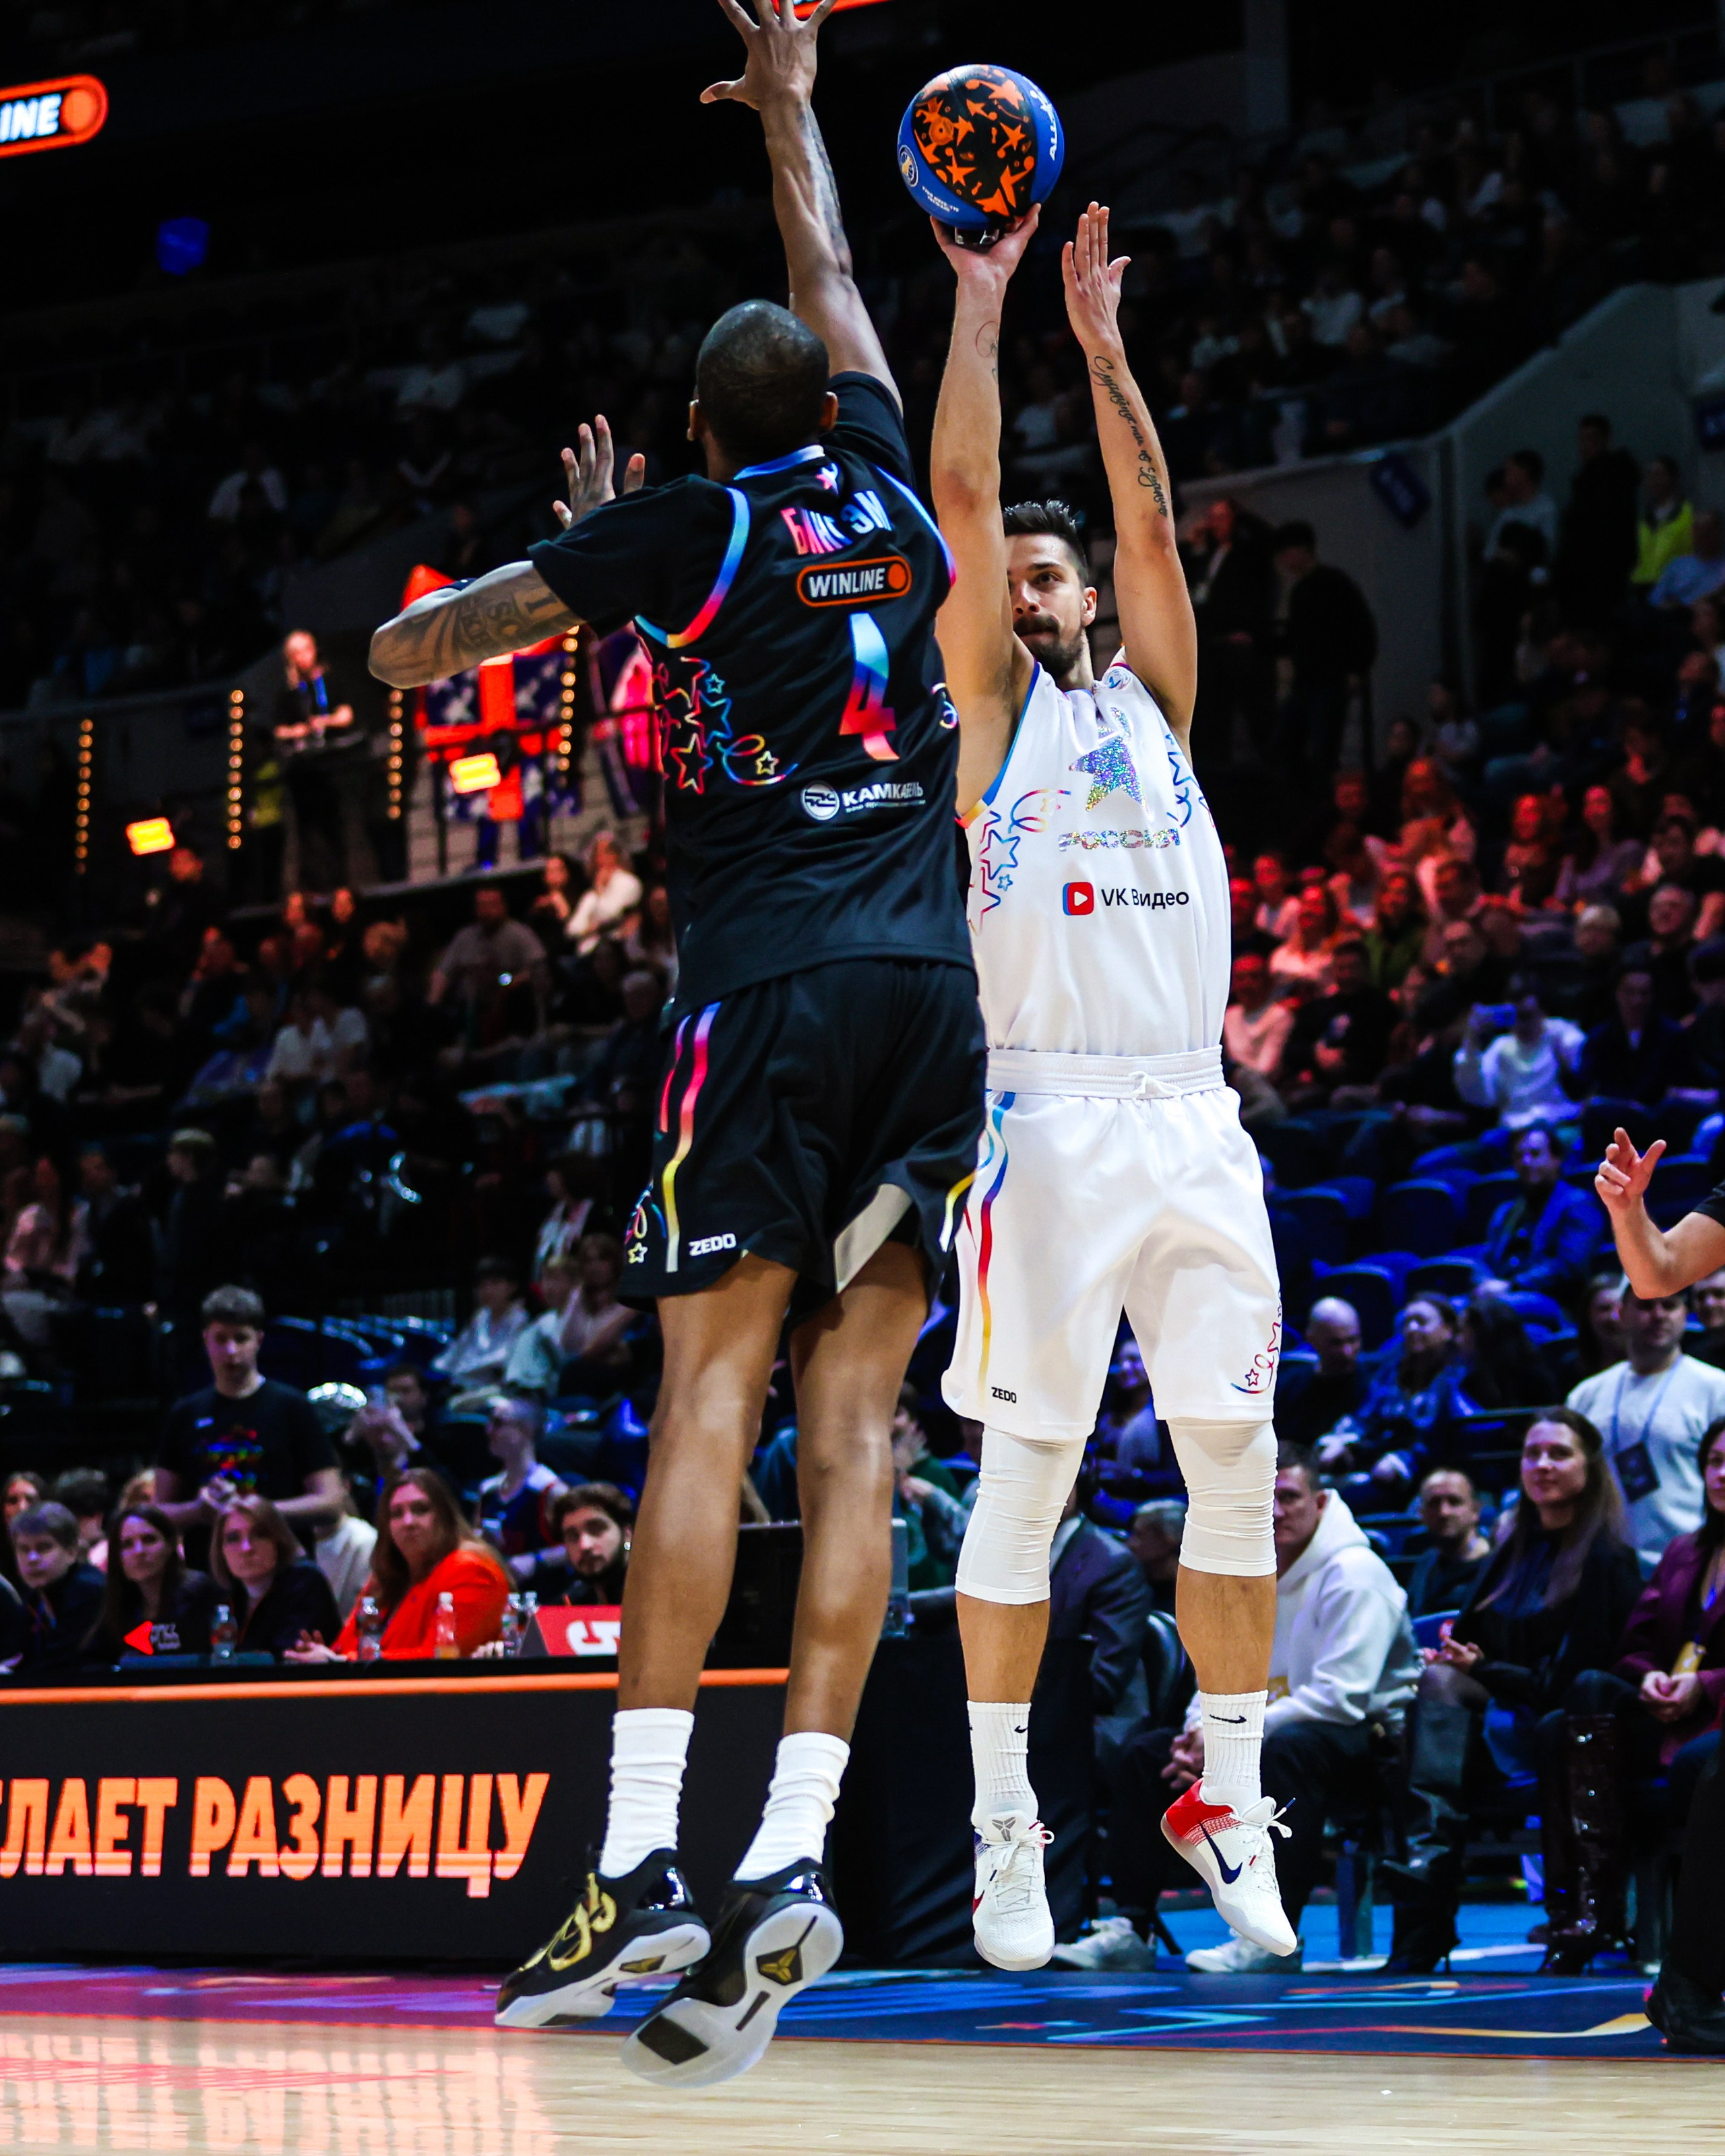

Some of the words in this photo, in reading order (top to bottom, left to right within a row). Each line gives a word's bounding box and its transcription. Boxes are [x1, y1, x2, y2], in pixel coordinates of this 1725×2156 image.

[809, 568, 886, 598] WINLINE
[839, 612, 900, 761] 4
[1058, 828, 1181, 852] РОССИЯ
[1100, 888, 1129, 907] VK
[1131, 888, 1190, 910] Видео
[689, 1233, 736, 1257] ZEDO
[991, 1387, 1017, 1403] ZEDO
[0, 1777, 179, 1878] ЛАЕТ
[189, 1773, 551, 1898] РАЗНИЦУ
